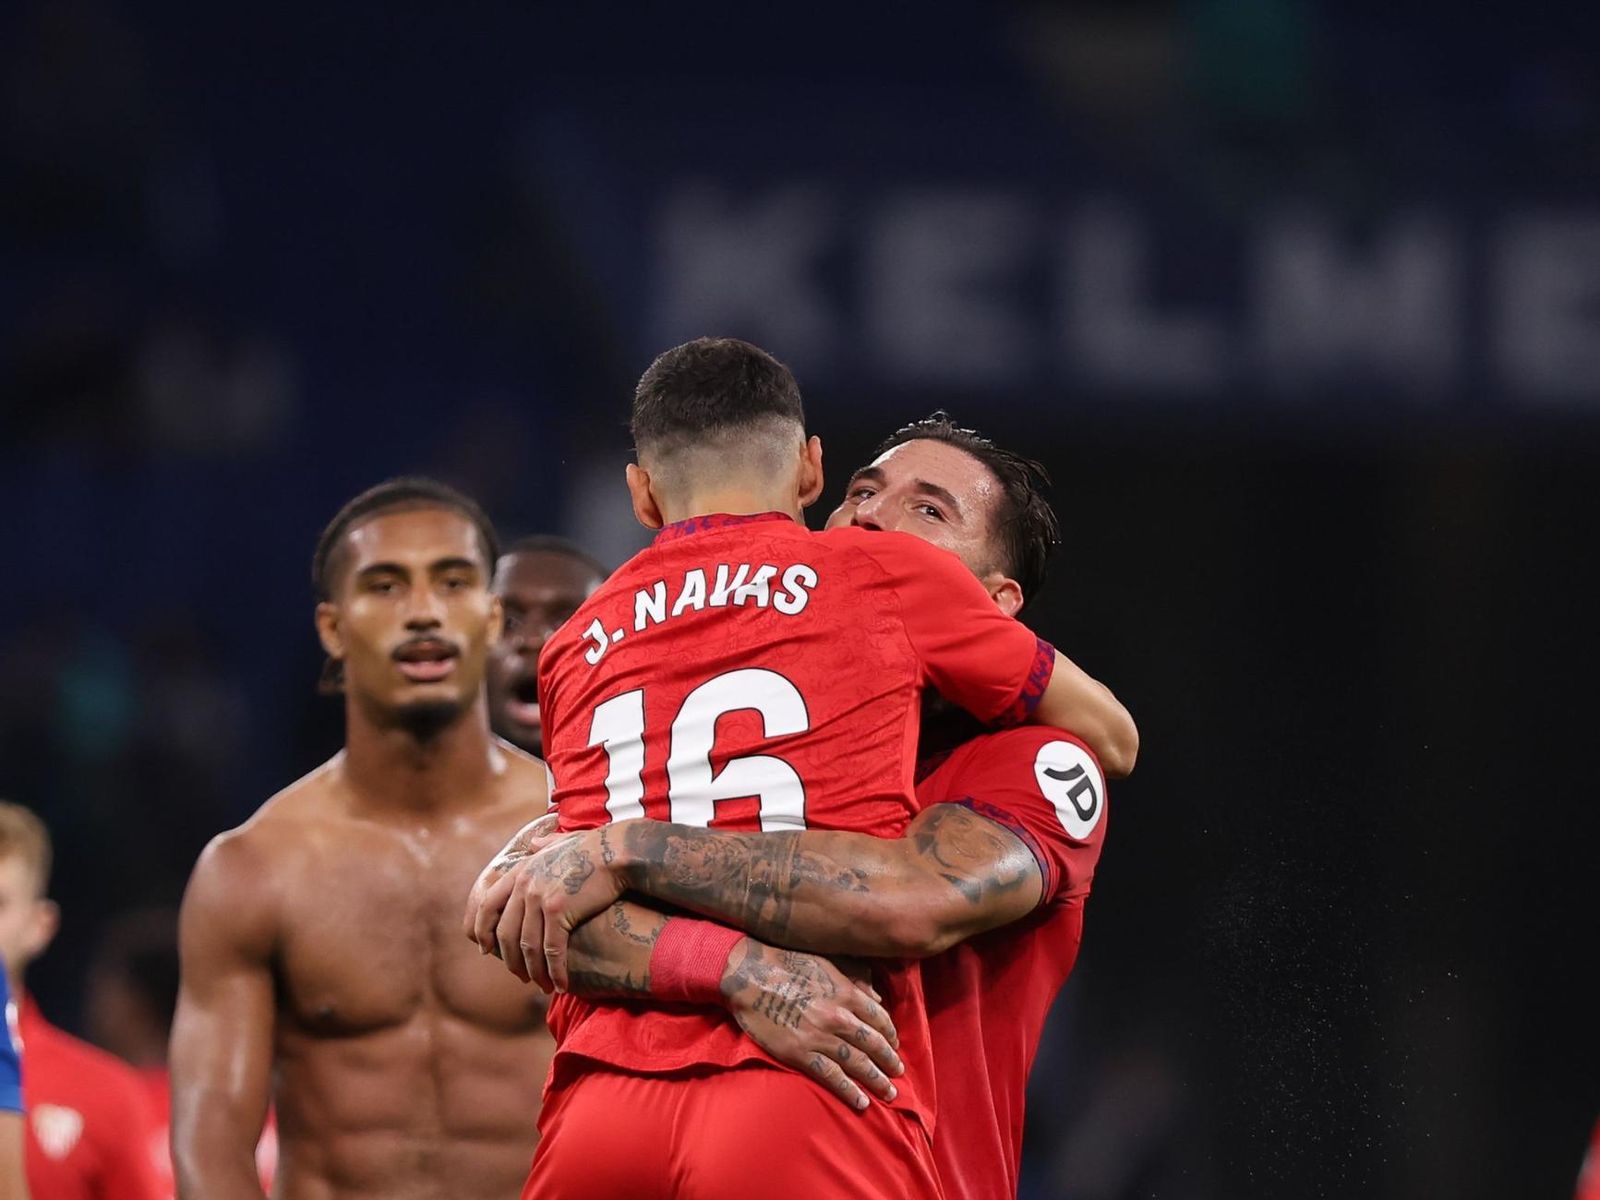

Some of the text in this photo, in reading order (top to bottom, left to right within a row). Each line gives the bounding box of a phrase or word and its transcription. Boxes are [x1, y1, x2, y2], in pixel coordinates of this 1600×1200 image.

[654, 186, 1600, 397] KELME
[581, 563, 819, 666] J. NAVAS
[587, 667, 810, 832] 16
[1043, 763, 1098, 822] JD
